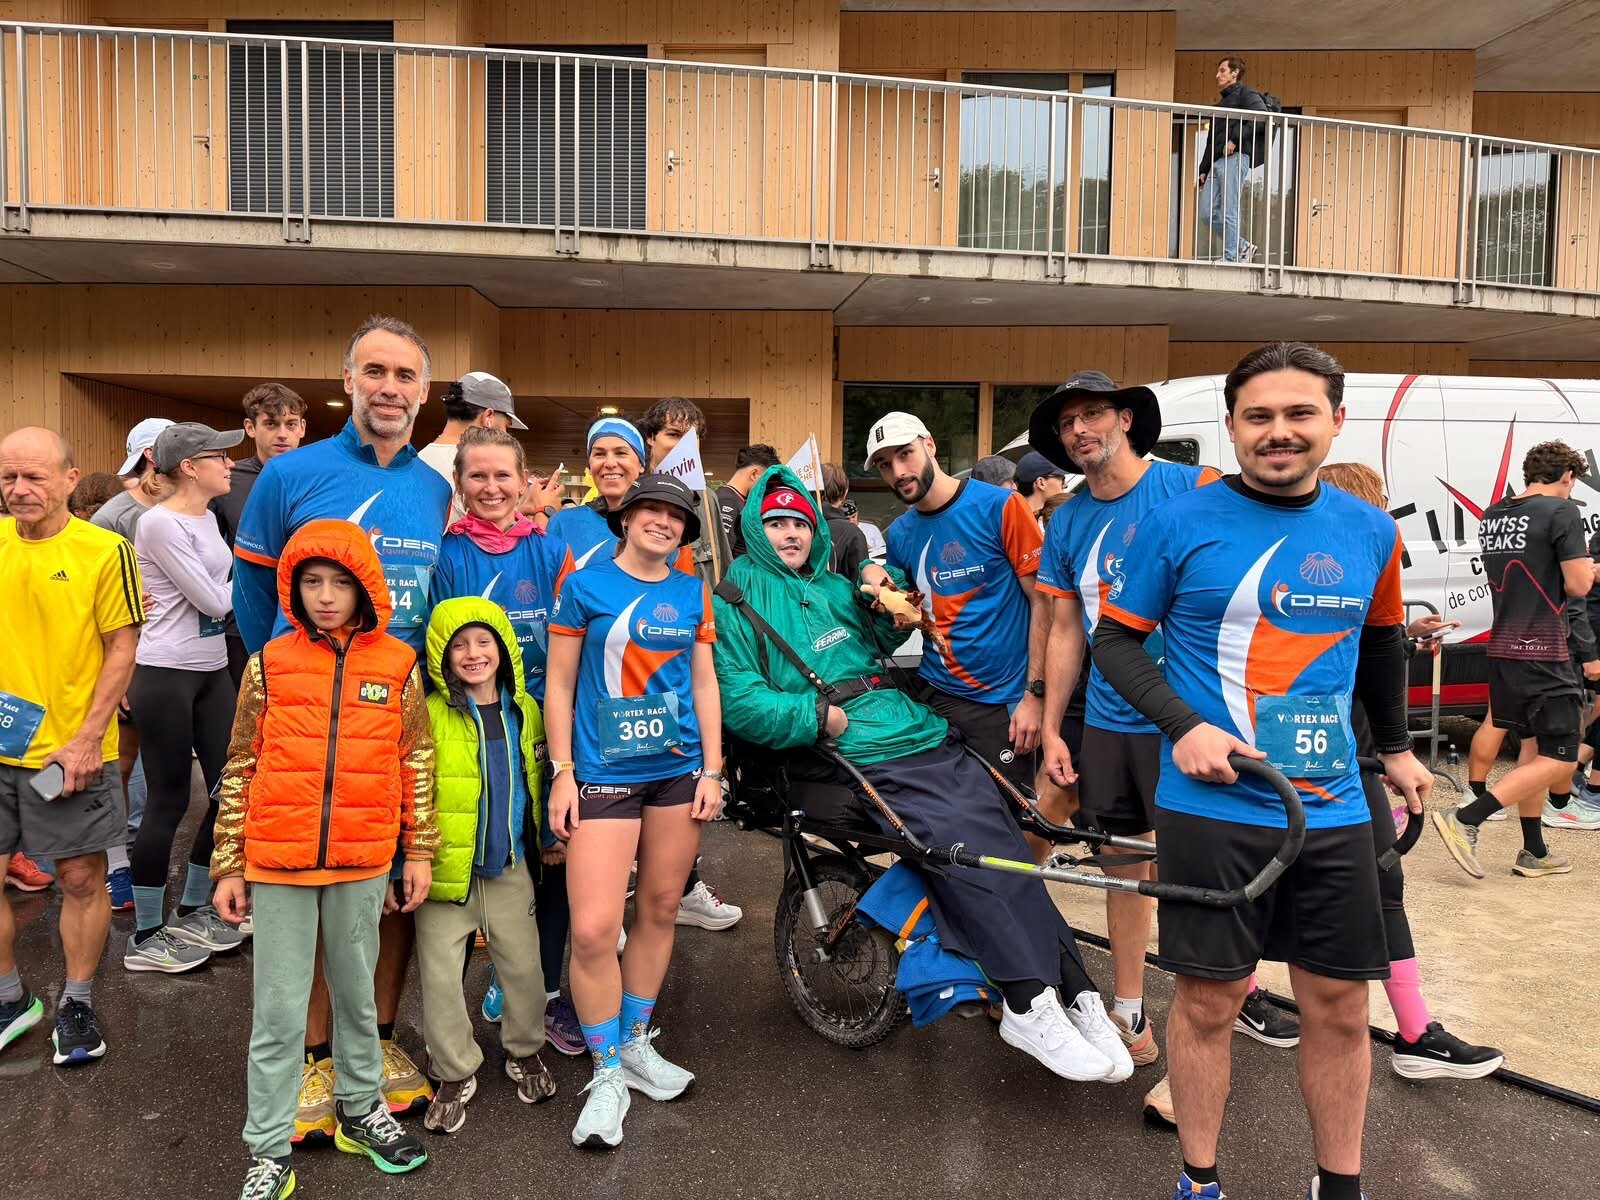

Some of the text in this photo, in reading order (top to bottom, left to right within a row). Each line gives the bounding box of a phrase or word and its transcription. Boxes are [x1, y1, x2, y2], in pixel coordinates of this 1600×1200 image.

[659, 457, 696, 478] rvin
[1479, 533, 1526, 551] PEAKS
[400, 580, 418, 588] RACE
[1448, 591, 1466, 610] de
[517, 635, 534, 643] RACE
[647, 707, 667, 716] RACE
[1320, 714, 1339, 724] RACE
[619, 718, 664, 741] 360
[1295, 729, 1328, 755] 56
